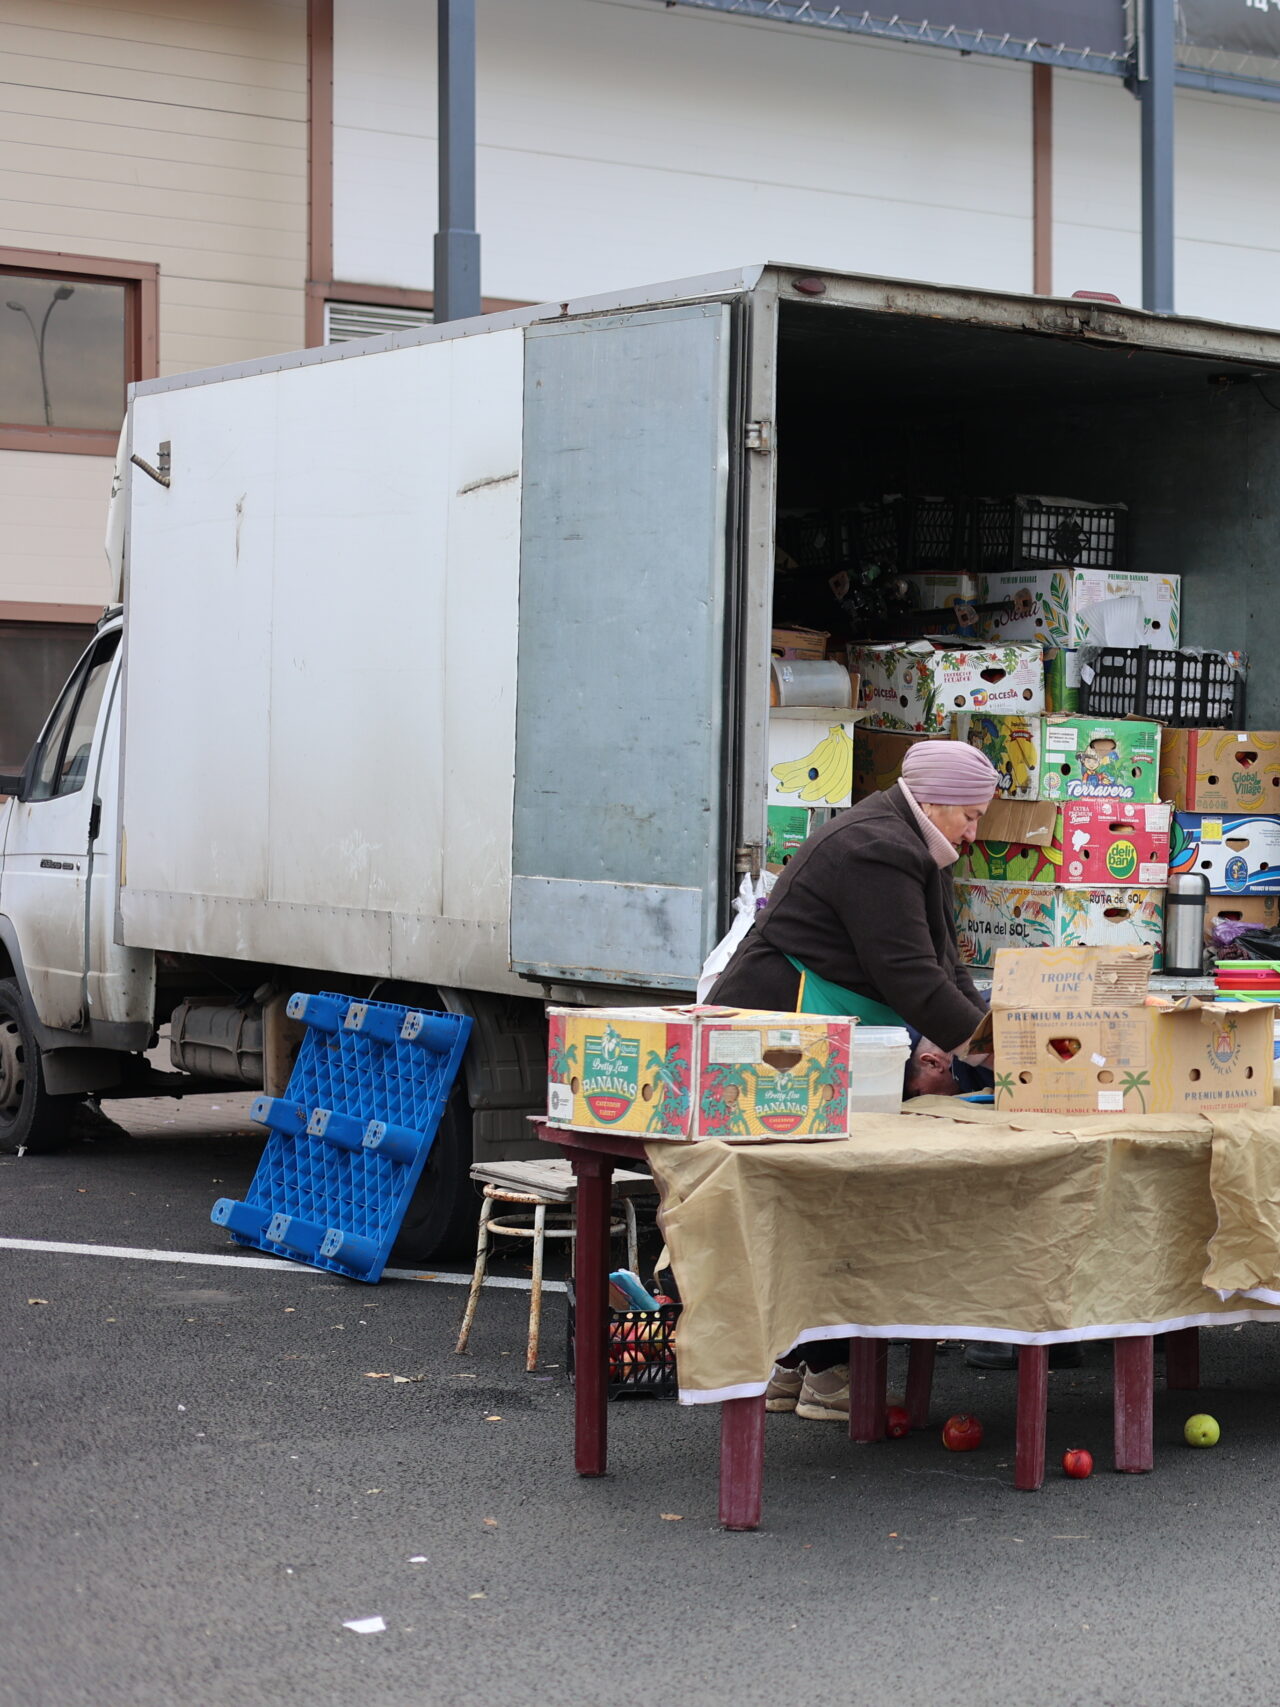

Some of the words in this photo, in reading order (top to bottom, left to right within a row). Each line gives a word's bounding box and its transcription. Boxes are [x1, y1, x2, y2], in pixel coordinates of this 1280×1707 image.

[1107, 573, 1129, 581] PREMIUM
[1232, 772, 1258, 784] Global
[1066, 780, 1135, 799] Terravera
[1234, 783, 1262, 796] Village
[1112, 845, 1132, 857] deli
[1108, 854, 1129, 867] ban
[1090, 894, 1112, 905] RUTA
[1128, 894, 1143, 905] SOL
[968, 920, 992, 935] RUTA
[994, 922, 1007, 935] del
[1009, 921, 1030, 938] SOL
[1055, 982, 1080, 992] LINE
[1007, 1011, 1061, 1021] PREMIUM
[1066, 1010, 1129, 1020] BANANAS
[583, 1075, 637, 1100] BANANAS
[1184, 1090, 1223, 1101] PREMIUM
[1225, 1089, 1257, 1099] BANANAS
[755, 1101, 808, 1116] BANANAS
